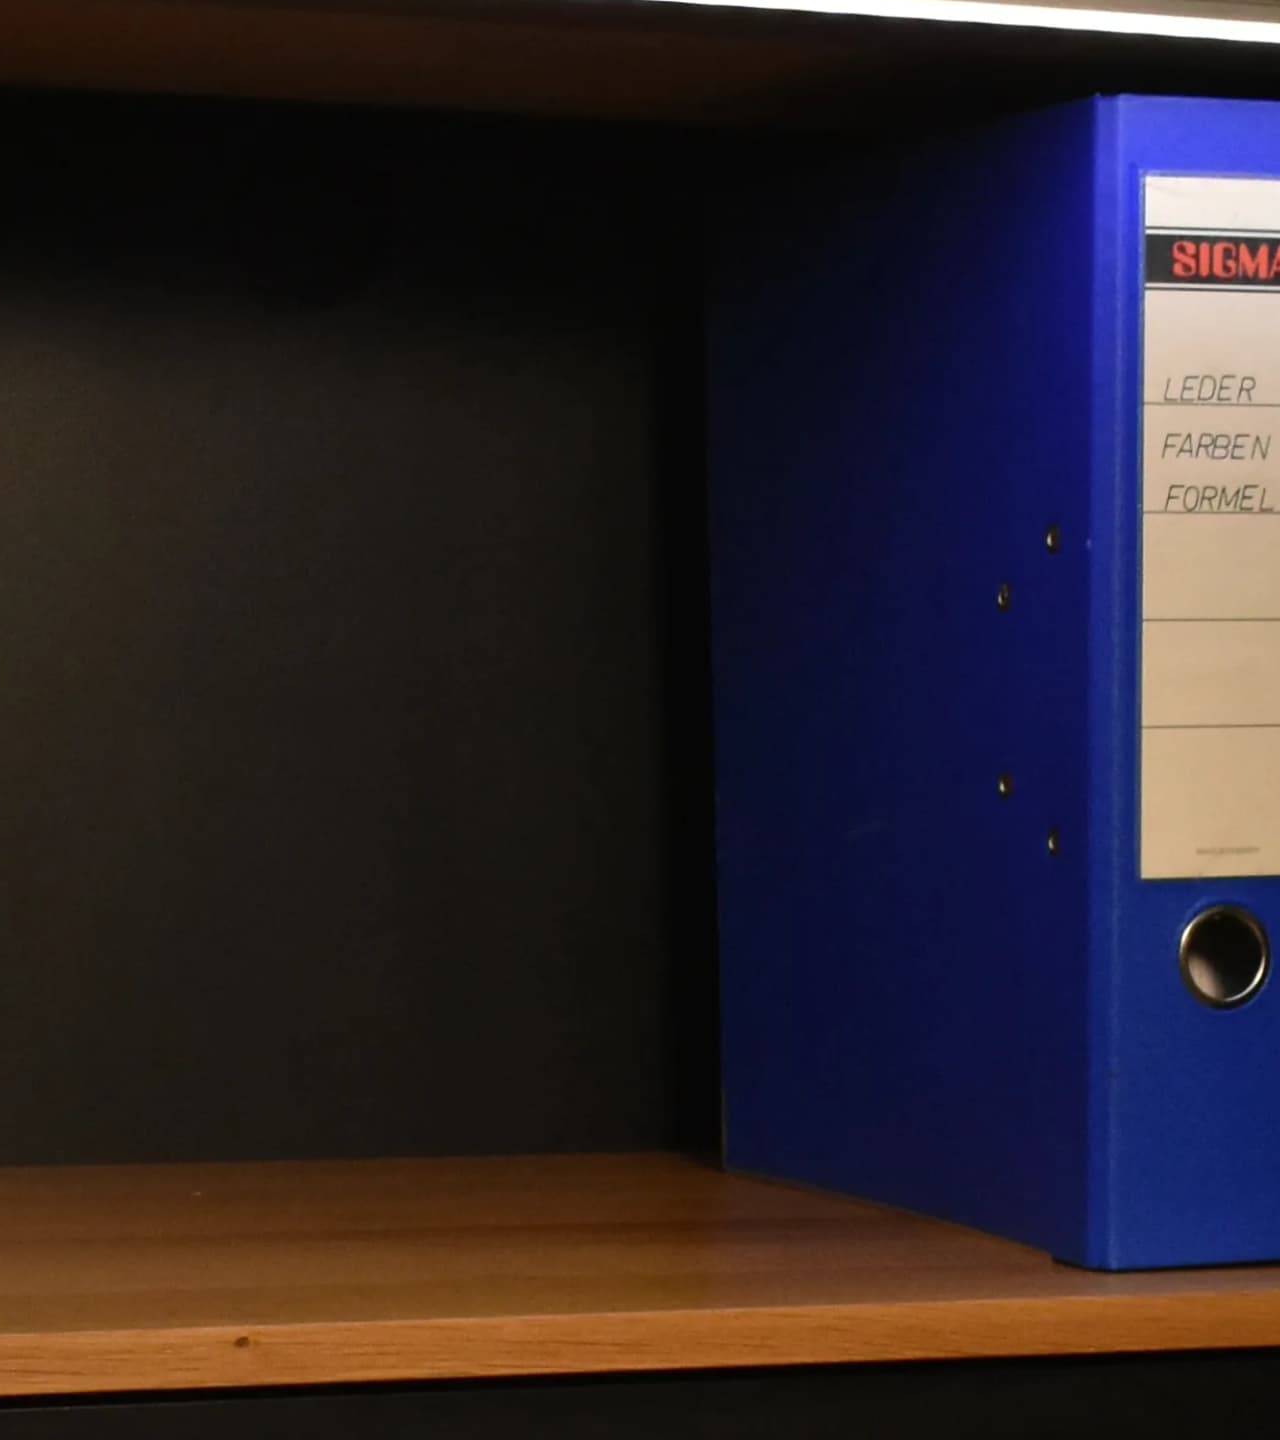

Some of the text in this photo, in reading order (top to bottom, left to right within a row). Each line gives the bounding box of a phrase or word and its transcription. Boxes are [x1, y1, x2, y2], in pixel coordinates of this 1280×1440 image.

[1162, 374, 1257, 403] LEDER
[1160, 432, 1272, 460] FARBEN
[1164, 484, 1275, 513] FORMEL
